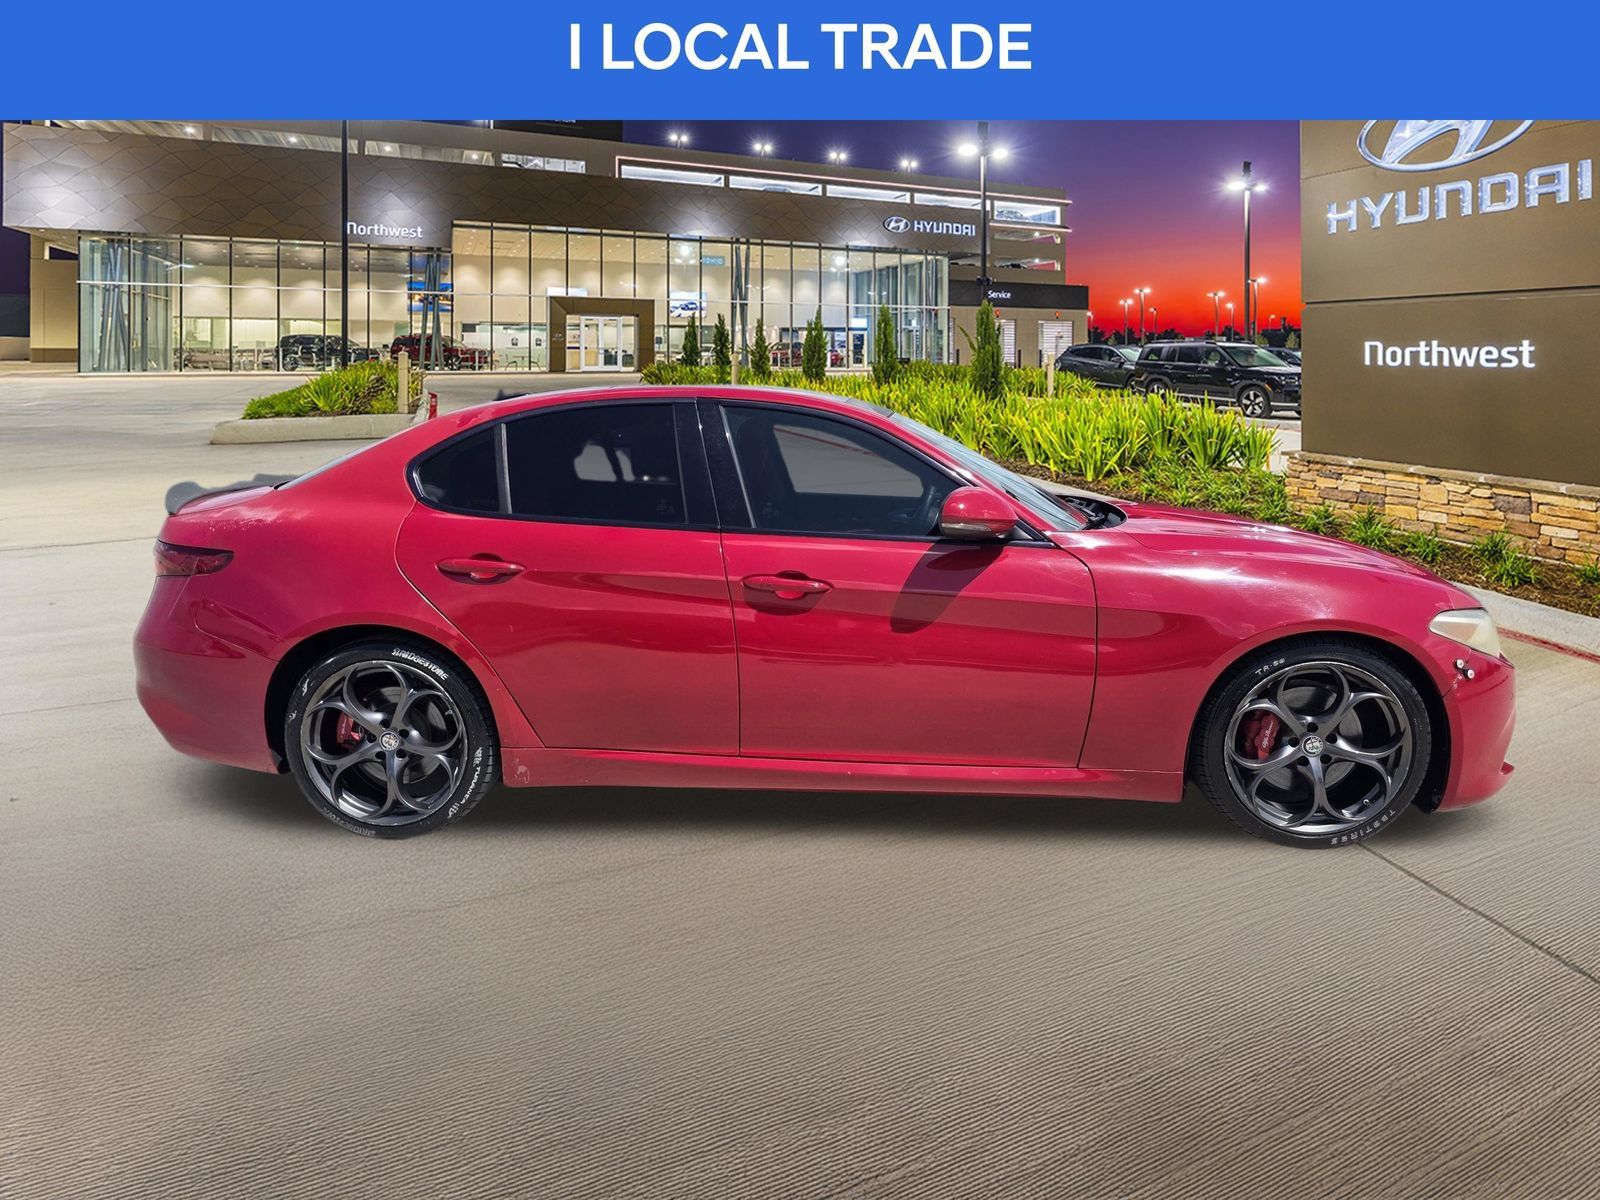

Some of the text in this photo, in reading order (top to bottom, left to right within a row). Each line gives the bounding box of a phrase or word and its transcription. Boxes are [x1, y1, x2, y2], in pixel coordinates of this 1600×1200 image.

[1326, 159, 1592, 235] HYUNDAI
[347, 221, 423, 238] Northwest
[913, 220, 977, 237] HYUNDAI
[987, 289, 1012, 299] Service
[1364, 340, 1536, 368] Northwest
